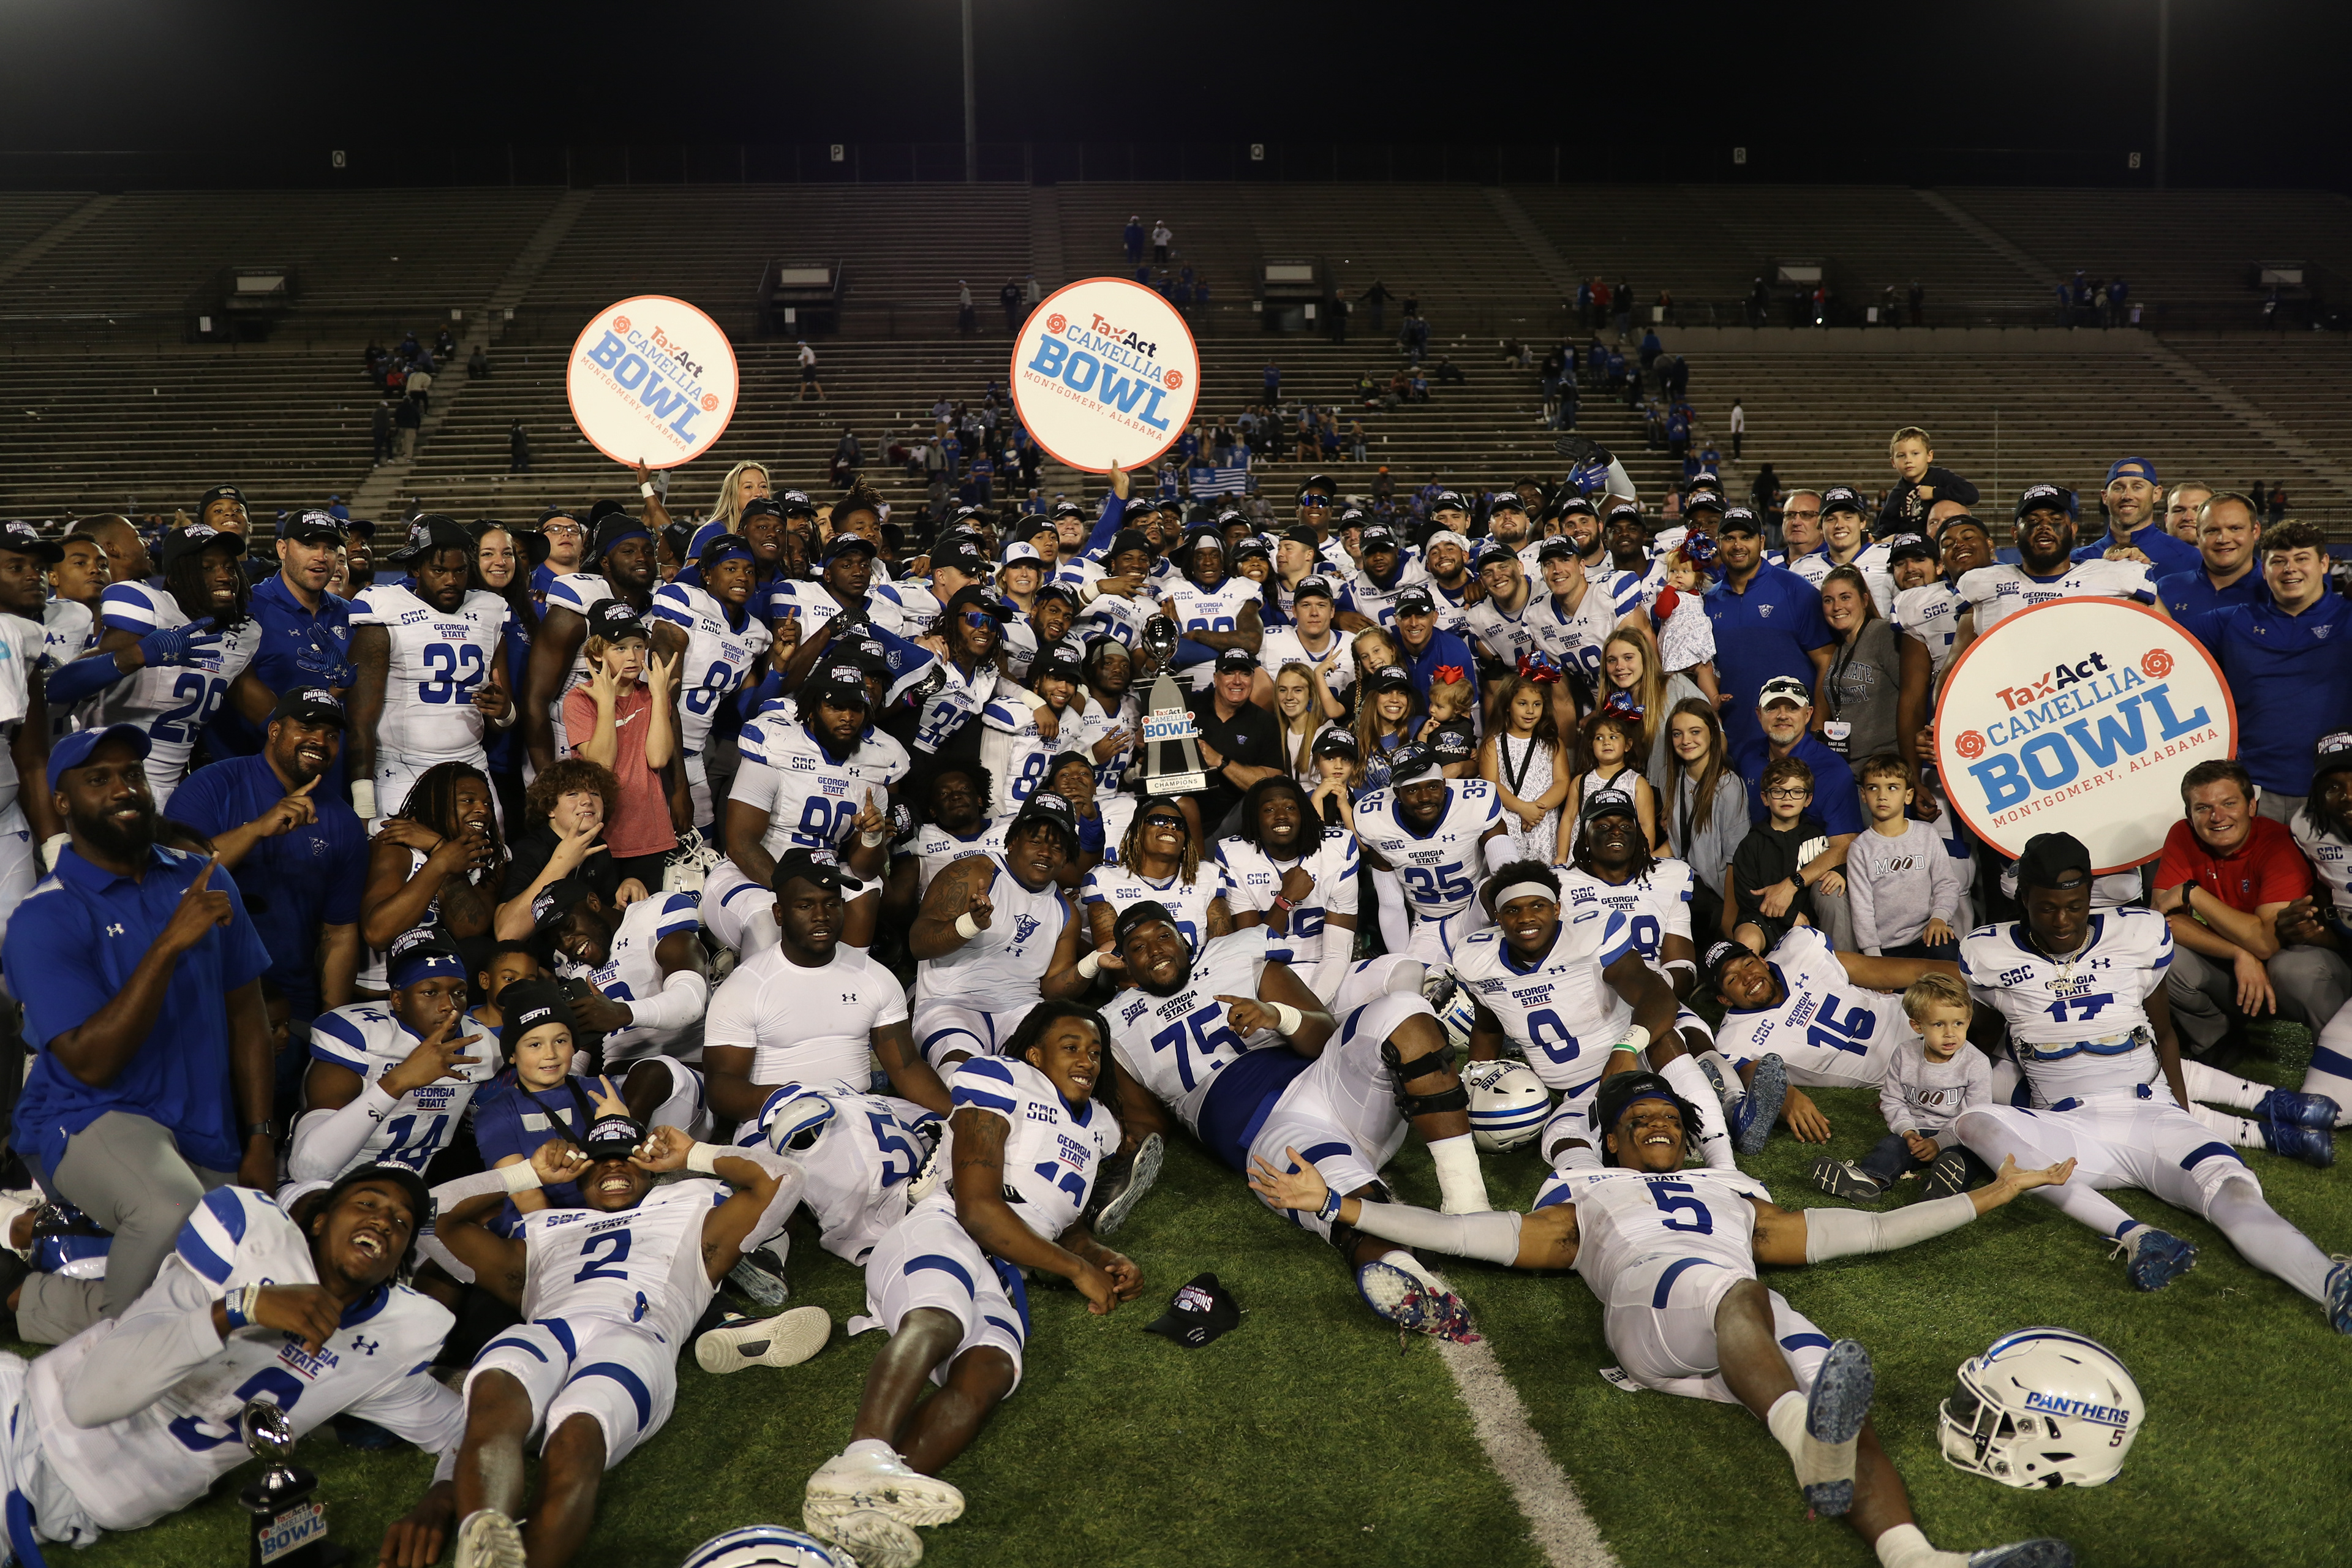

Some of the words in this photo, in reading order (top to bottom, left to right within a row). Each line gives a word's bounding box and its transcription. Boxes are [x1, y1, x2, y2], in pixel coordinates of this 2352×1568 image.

[1091, 312, 1156, 358] TaxAct
[650, 325, 703, 379] TaxAct
[1066, 325, 1161, 383] CAMELLIA
[627, 330, 704, 401] CAMELLIA
[587, 329, 701, 445] BOWL
[1028, 333, 1170, 431] BOWL
[581, 356, 642, 415] MONTGOMERY,
[644, 413, 687, 452] ALABAMA
[1023, 371, 1105, 415] MONTGOMERY,
[1109, 411, 1163, 441] ALABAMA
[1826, 490, 1853, 501] CHAMPIONS
[2024, 485, 2058, 500] CHAMPIONS
[1725, 508, 1752, 519] CHAMPIONS
[1360, 587, 1377, 596] SBC
[1996, 581, 2019, 592] SBC
[1174, 591, 1193, 600] SBC
[813, 605, 835, 617] SBC
[1107, 600, 1131, 616] GEORGIA
[1110, 605, 1127, 619] STATE
[1923, 603, 1949, 619] SBC
[401, 609, 429, 625] SBC
[434, 624, 470, 632] GEORGIA
[441, 630, 467, 639] STATE
[701, 618, 722, 635] SBC
[1486, 624, 1504, 636] SBC
[1541, 624, 1555, 636] SBC
[1559, 631, 1582, 643] GEORGIA
[721, 641, 745, 658] GEORGIA
[723, 649, 741, 663] STATE
[201, 660, 220, 671] STATE
[418, 643, 485, 704] 32
[1996, 650, 2108, 712] TaxAct
[954, 690, 975, 705] GEORGIA
[954, 696, 970, 707] STATE
[1986, 666, 2146, 747] CAMELLIA
[1083, 715, 1101, 725] SBC
[1150, 714, 1186, 723] CAMELLIA
[1144, 721, 1197, 737] BOWL
[1967, 682, 2211, 815] BOWL
[2318, 734, 2352, 753] CHAMPION
[792, 756, 816, 771] SBC
[818, 776, 850, 788] GEORGIA
[1155, 778, 1197, 788] CHAMPIONS
[1992, 769, 2123, 829] MONTGOMERY,
[2130, 728, 2218, 772] ALABAMA
[823, 785, 845, 795] STATE
[1594, 791, 1627, 804] CHAMPIONS
[1035, 794, 1067, 812] CHAMPIONS
[1360, 791, 1384, 814] 35
[927, 840, 951, 854] SBC
[1379, 840, 1406, 850] SBC
[1408, 849, 1445, 858] GEORGIA
[2317, 846, 2344, 860] SBC
[954, 848, 987, 860] GEORGIA
[1247, 873, 1270, 885] SBC
[1404, 861, 1473, 905] 35
[1116, 888, 1142, 899] SBC
[1571, 886, 1595, 899] SBC
[1601, 895, 1640, 905] GEORGIA
[391, 930, 435, 957] CHAMPIONS
[1705, 941, 1733, 968] CHAMPIONS
[587, 959, 620, 979] GEORGIA
[591, 968, 616, 982] STATE
[1999, 965, 2035, 988] SBC
[1476, 978, 1504, 989] SBC
[1512, 983, 1555, 999] GEORGIA
[2055, 984, 2091, 998] STATE
[1156, 990, 1198, 1017] GEORGIA
[1521, 993, 1552, 1005] STATE
[519, 1006, 551, 1025] ESPN
[1121, 998, 1146, 1019] SBC
[1164, 1000, 1195, 1018] STATE
[1785, 991, 1812, 1027] GEORGIA
[1796, 1000, 1817, 1027] STATE
[2043, 993, 2114, 1023] 17
[1751, 1019, 1775, 1046] SBC
[1807, 993, 1876, 1057] 15
[1527, 1008, 1580, 1065] 0
[413, 1087, 455, 1097] GEORGIA
[417, 1098, 447, 1108] STATE
[1027, 1102, 1058, 1125] SBC
[376, 1114, 450, 1164] 14
[588, 1125, 638, 1142] CHAMPIONS
[1057, 1133, 1091, 1161] GEORGIA
[1060, 1147, 1085, 1168] STATE
[1651, 1183, 1713, 1235] 5
[546, 1212, 586, 1227] SBC
[584, 1212, 642, 1229] GEORGIA
[590, 1219, 631, 1231] STATE
[574, 1228, 631, 1284] 2
[281, 1344, 324, 1378] STATE
[2026, 1392, 2130, 1424] PANTHERS
[2109, 1430, 2126, 1447] 5
[276, 1504, 306, 1524] TaxAct
[270, 1512, 313, 1536] CAMELLIA
[262, 1515, 325, 1555] BOWL
